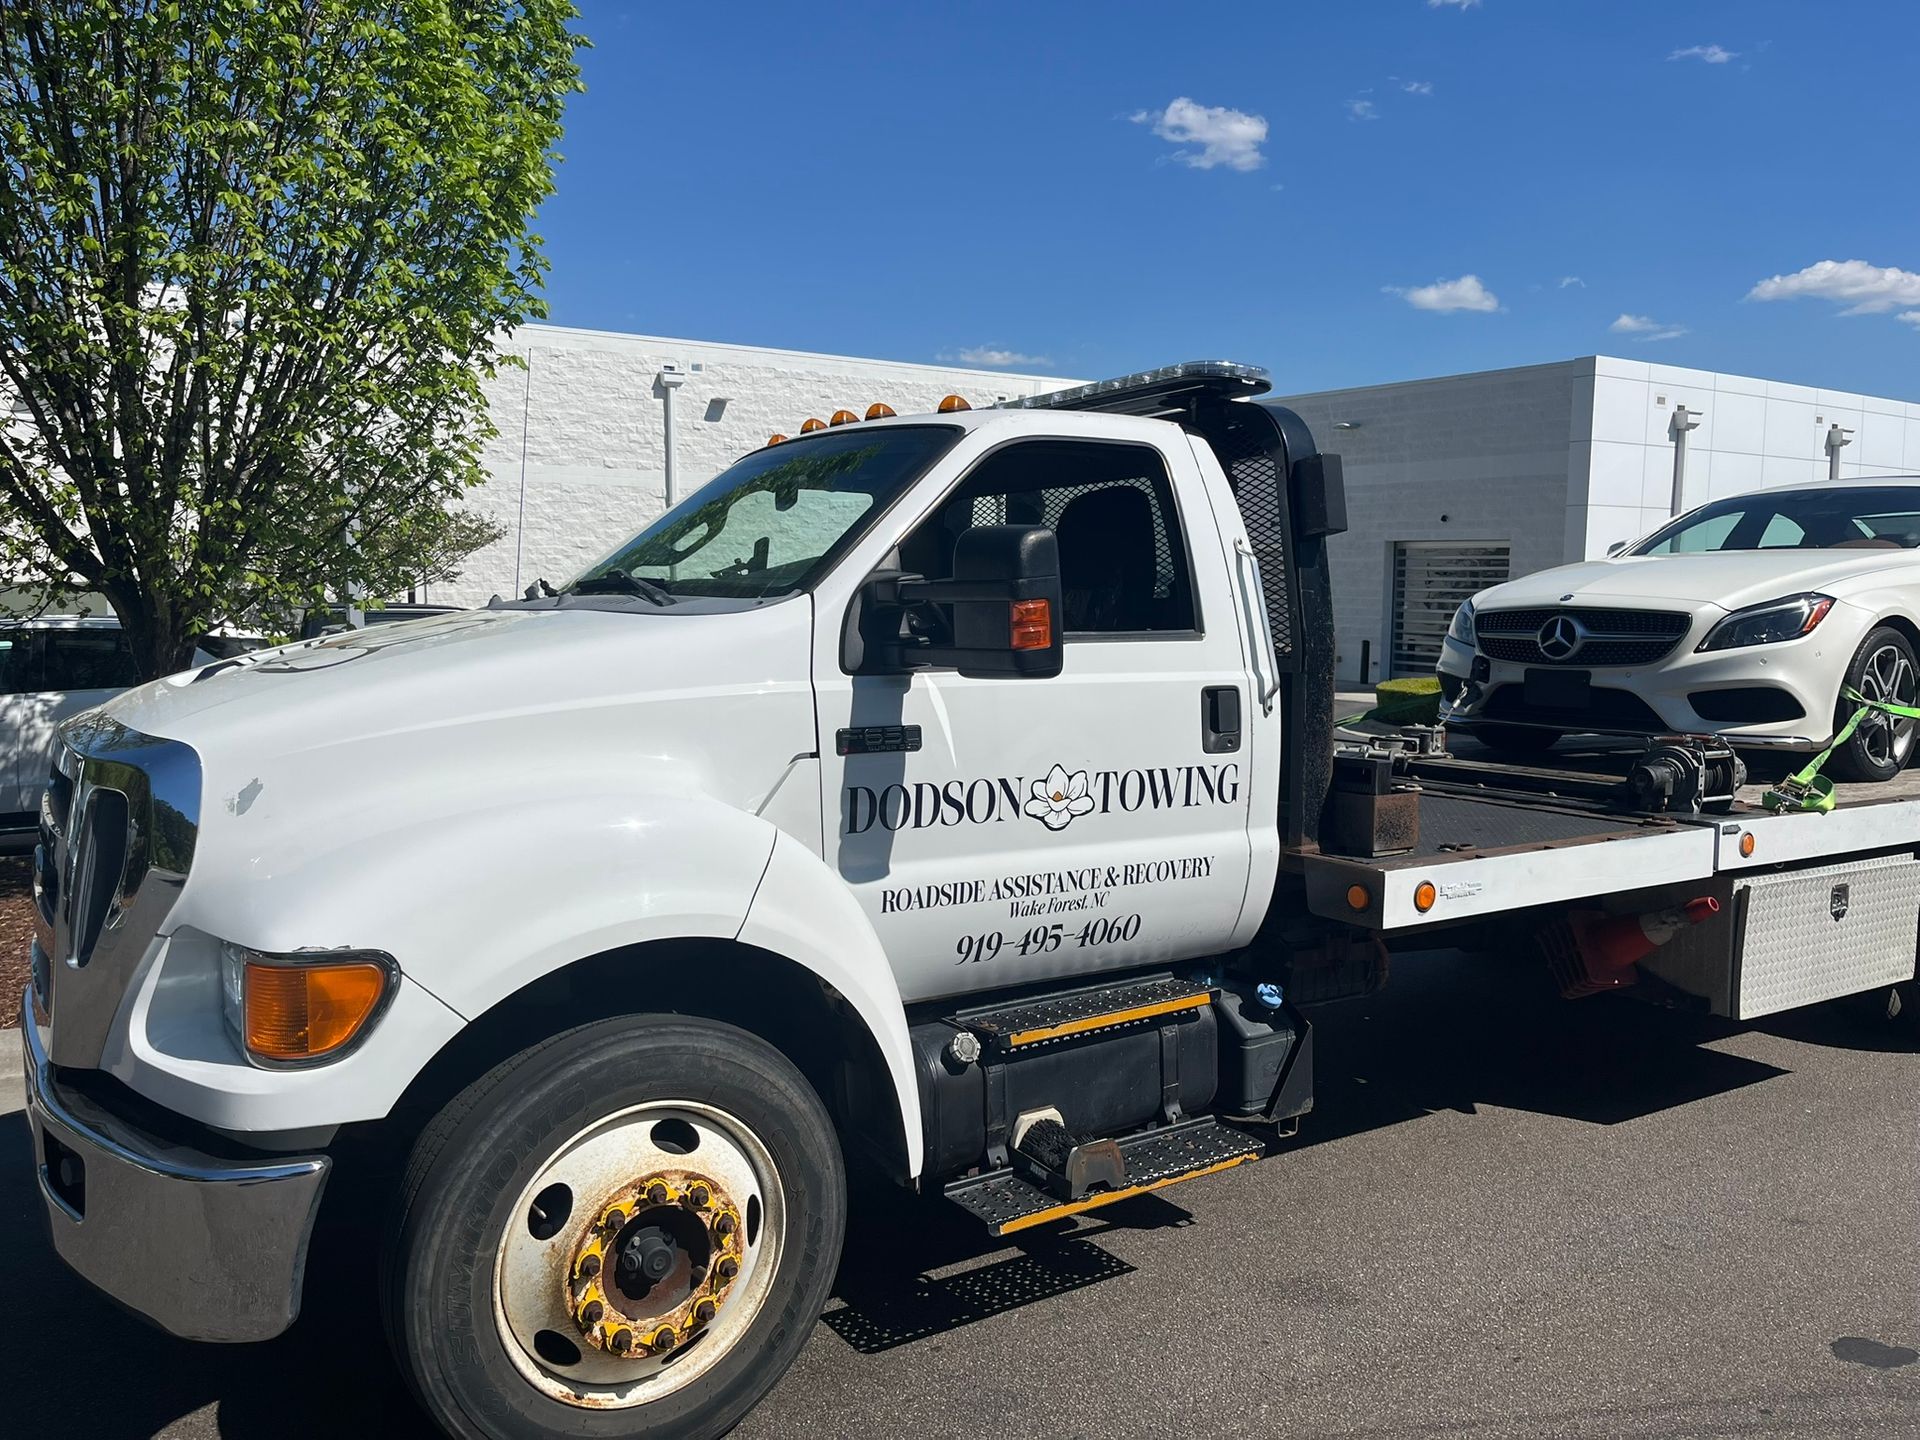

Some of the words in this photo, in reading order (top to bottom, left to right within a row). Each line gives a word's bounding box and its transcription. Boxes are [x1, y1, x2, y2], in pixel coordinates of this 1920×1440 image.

[846, 777, 1024, 834] DODSON
[1094, 764, 1239, 814] TOWING
[881, 880, 986, 914] ROADSIDE
[989, 868, 1102, 901] ASSISTANCE
[1104, 866, 1120, 888] &
[1123, 856, 1215, 886] RECOVERY
[1009, 900, 1046, 919] Wake
[1090, 891, 1110, 909] NC
[955, 913, 1142, 966] 919-495-4060
[445, 1083, 588, 1369] SUMITOMO
